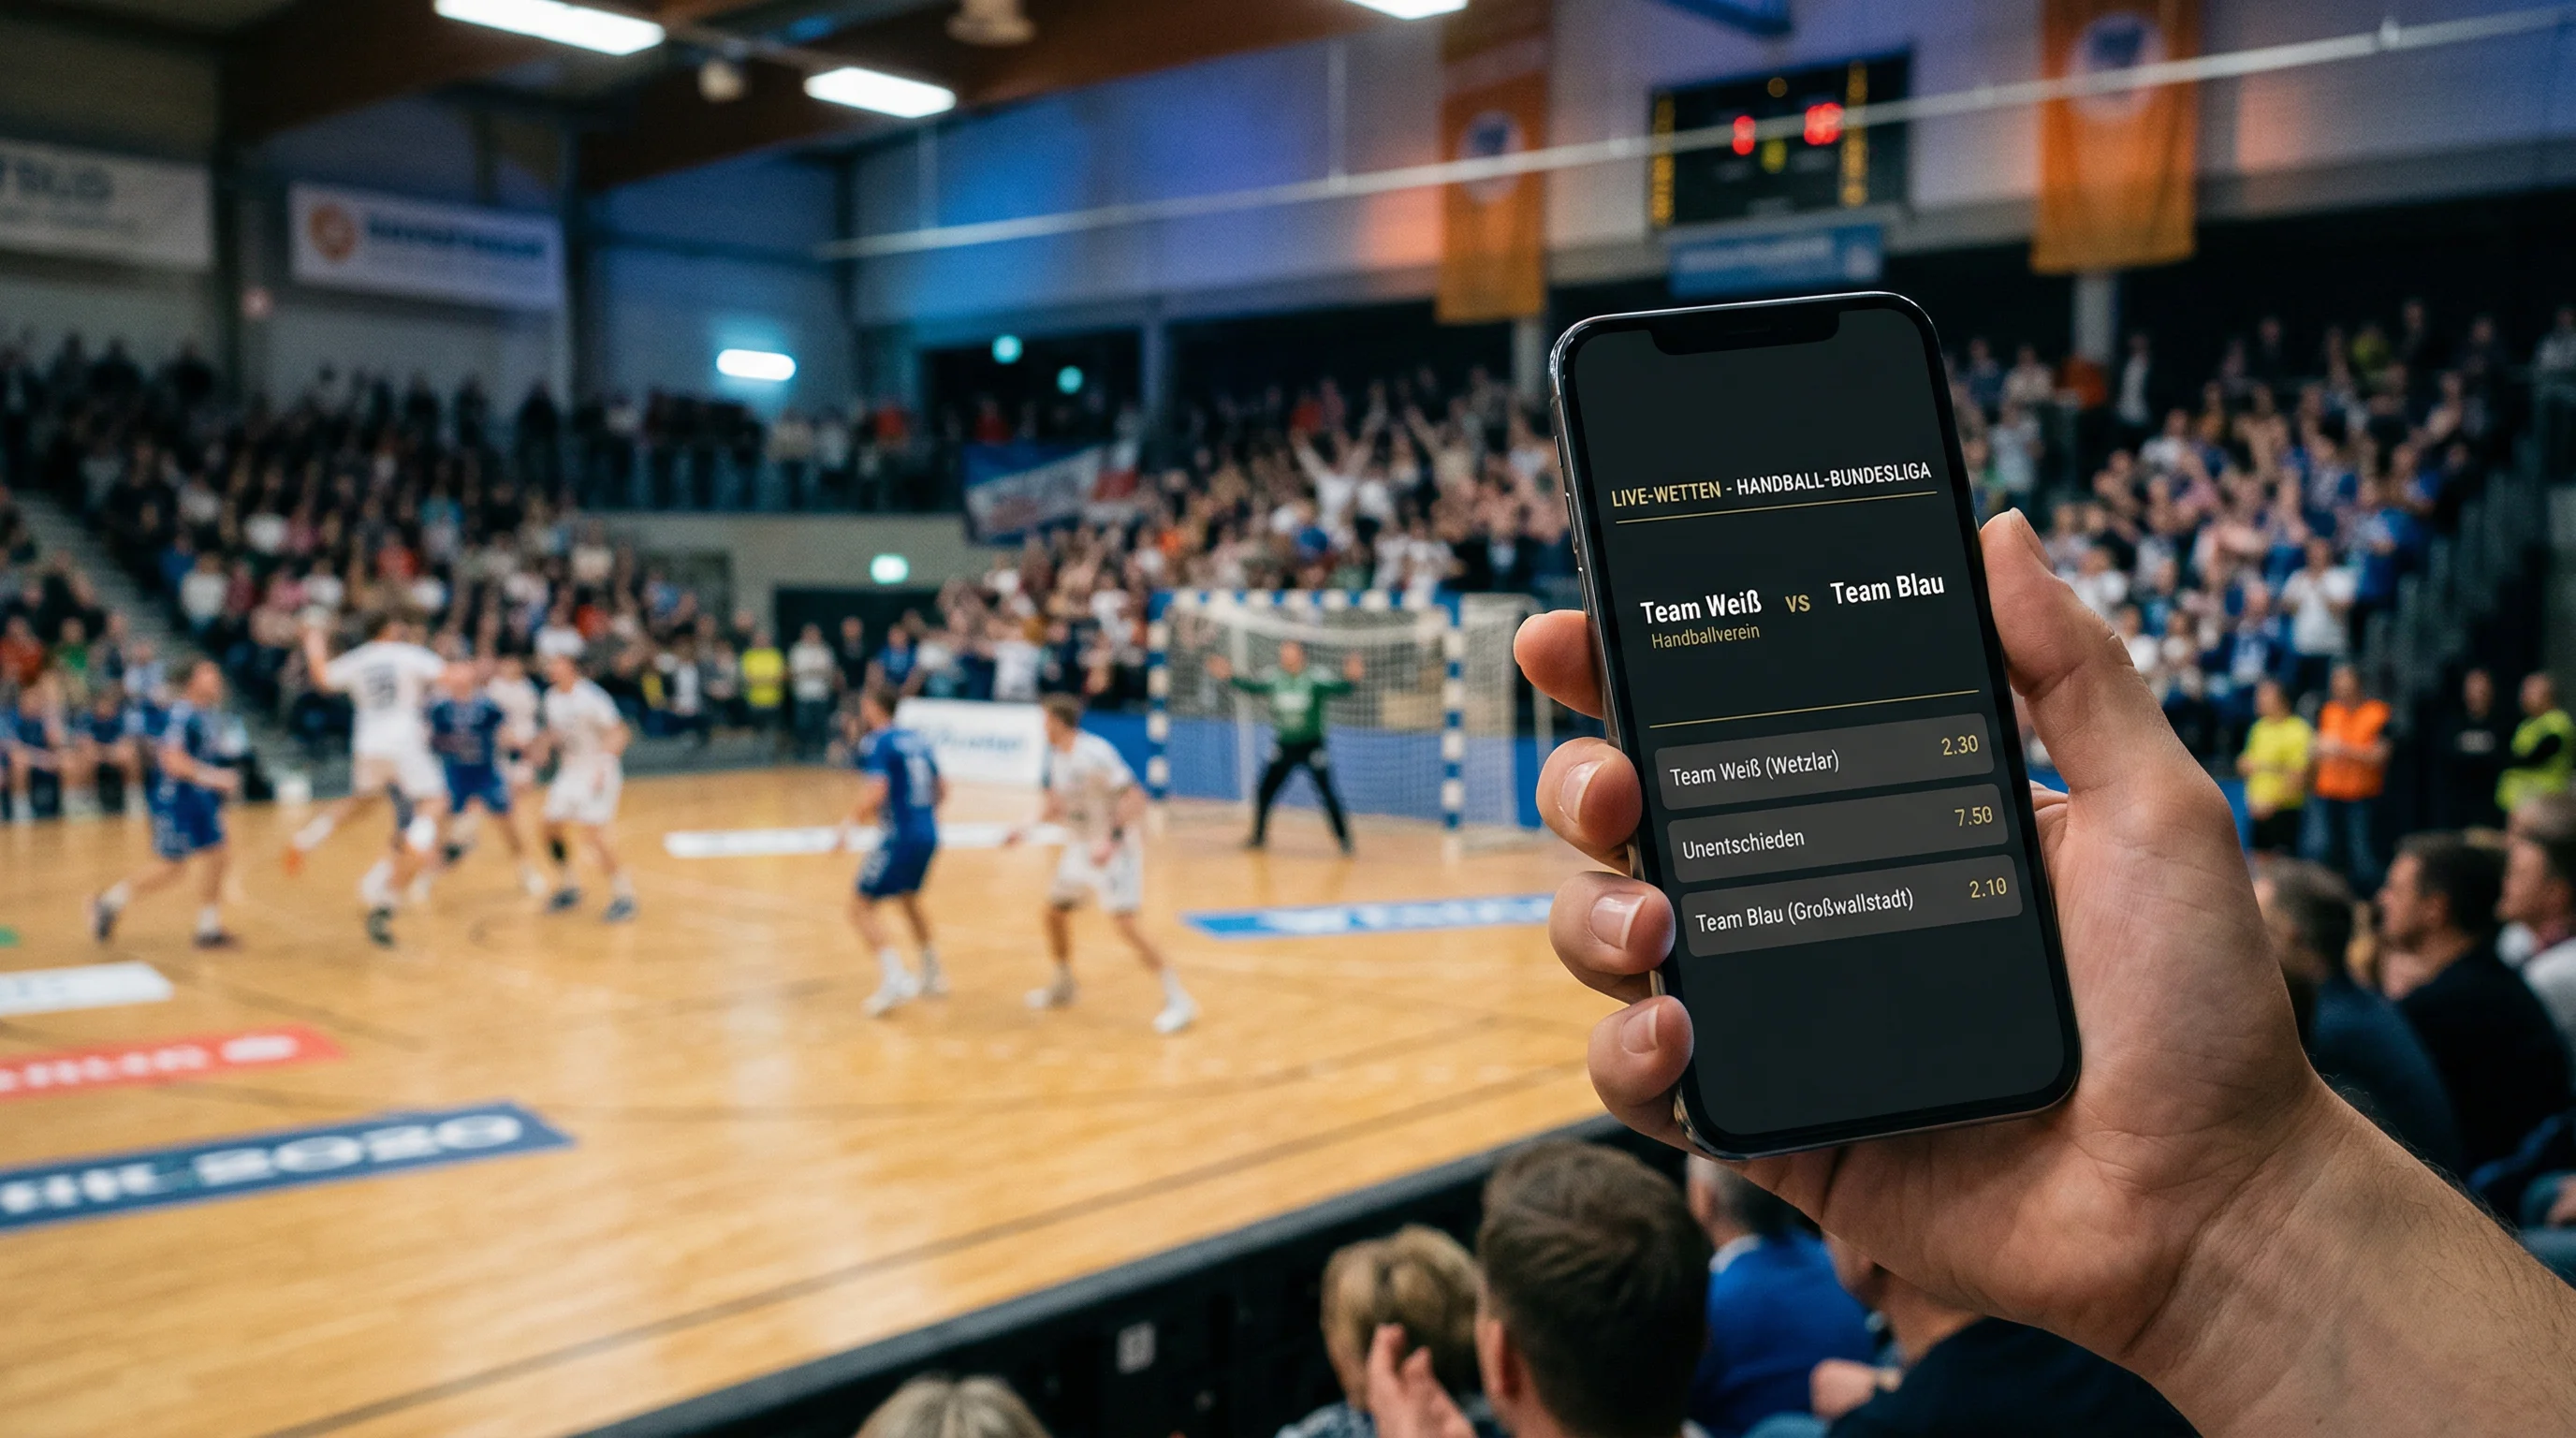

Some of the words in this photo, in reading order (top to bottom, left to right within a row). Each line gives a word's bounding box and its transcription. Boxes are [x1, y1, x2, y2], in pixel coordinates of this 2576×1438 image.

[1611, 480, 1721, 507] LIVE-WETTEN
[1736, 462, 1932, 496] HANDBALL-BUNDESLIGA
[1639, 601, 1702, 624] Team
[1705, 589, 1763, 618] Weiß
[1829, 581, 1892, 605] Team
[1895, 572, 1945, 598] Blau
[1651, 623, 1760, 649] Handballverein
[1669, 768, 1717, 786] Team
[1719, 757, 1762, 781] Weiß
[1765, 749, 1839, 780] (Wetzlar)
[1940, 734, 1979, 756] 2.30
[1682, 829, 1805, 859] Unentschieden
[1954, 805, 1993, 827] 7.50
[1695, 913, 1743, 932] Team
[1746, 905, 1784, 927] Blau
[1788, 887, 1913, 926] (Großwallstadt)
[1969, 877, 2007, 899] 2.10
